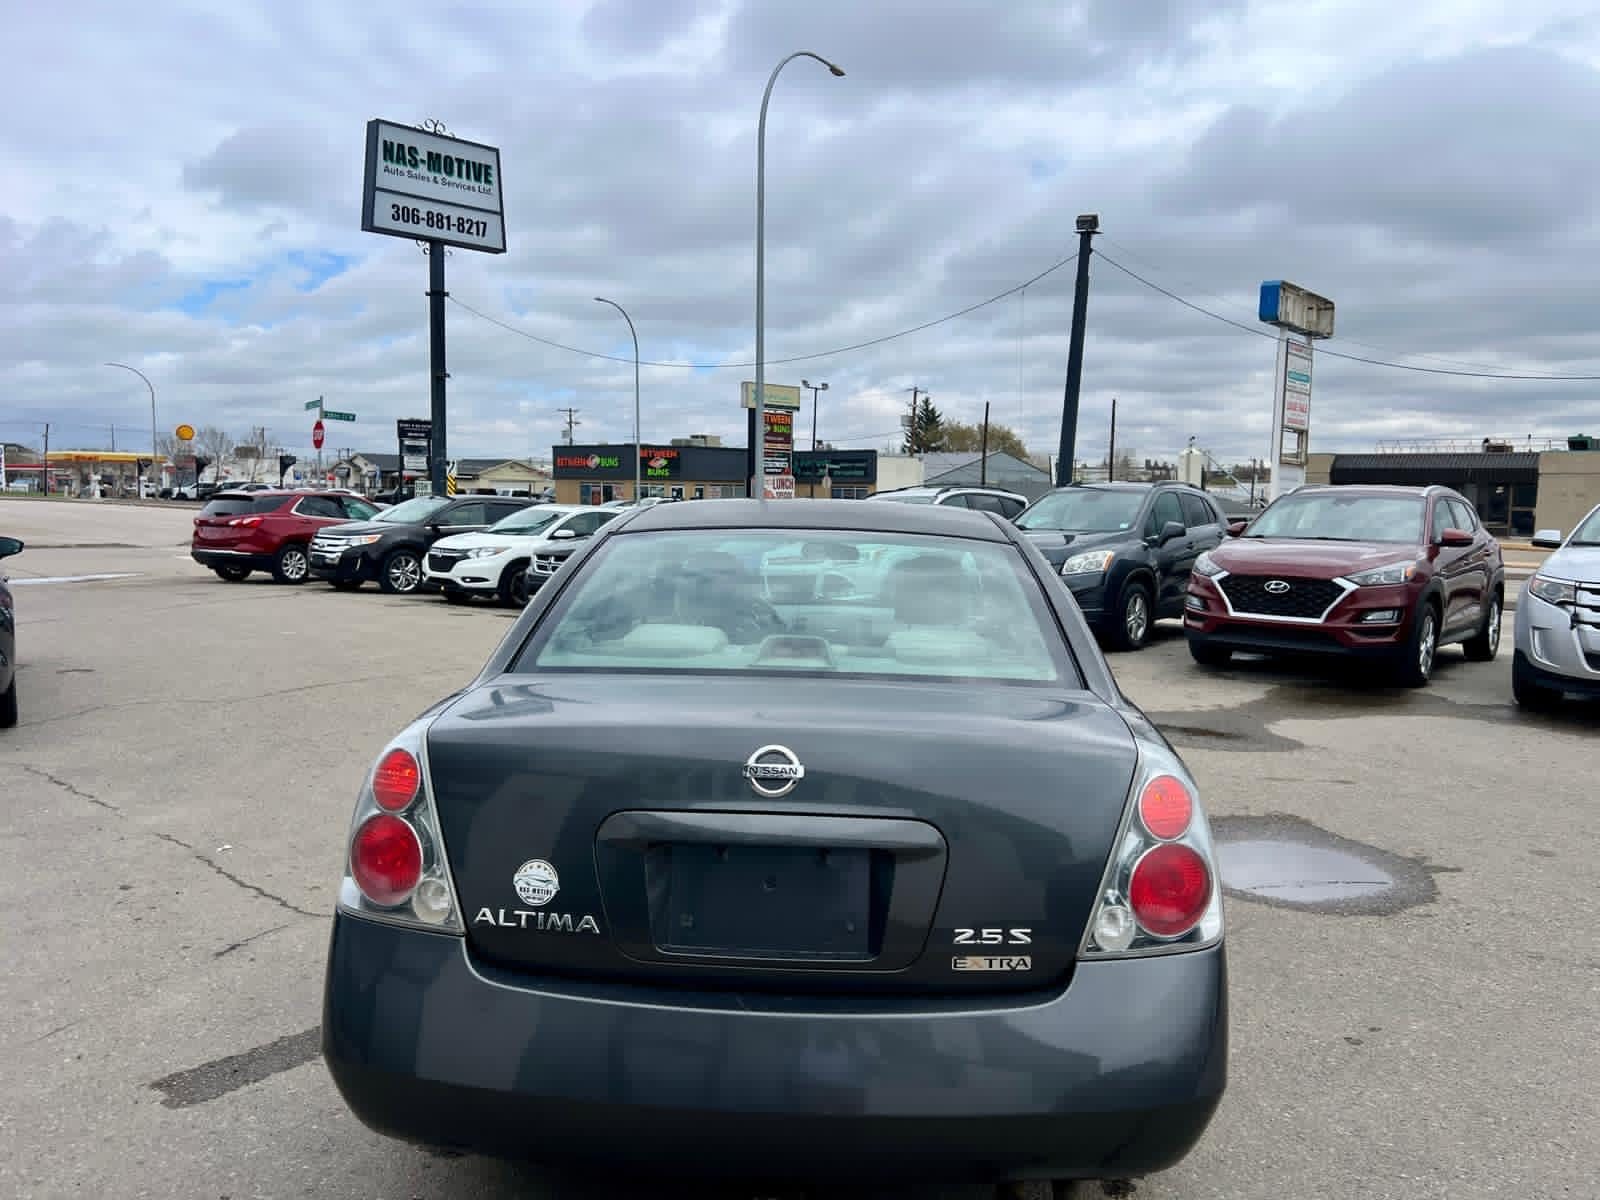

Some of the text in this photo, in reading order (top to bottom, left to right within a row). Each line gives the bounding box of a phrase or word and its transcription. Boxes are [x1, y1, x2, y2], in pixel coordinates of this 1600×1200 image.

[382, 139, 493, 185] NAS-MOTIVE
[383, 165, 405, 177] Auto
[406, 170, 431, 183] Sales
[432, 175, 440, 185] &
[440, 177, 477, 193] Services
[391, 203, 488, 238] 306-881-8217
[749, 766, 799, 777] NISSAN
[473, 906, 600, 934] ALTIMA
[1008, 928, 1032, 944] S
[952, 957, 1030, 969] EXTRA
